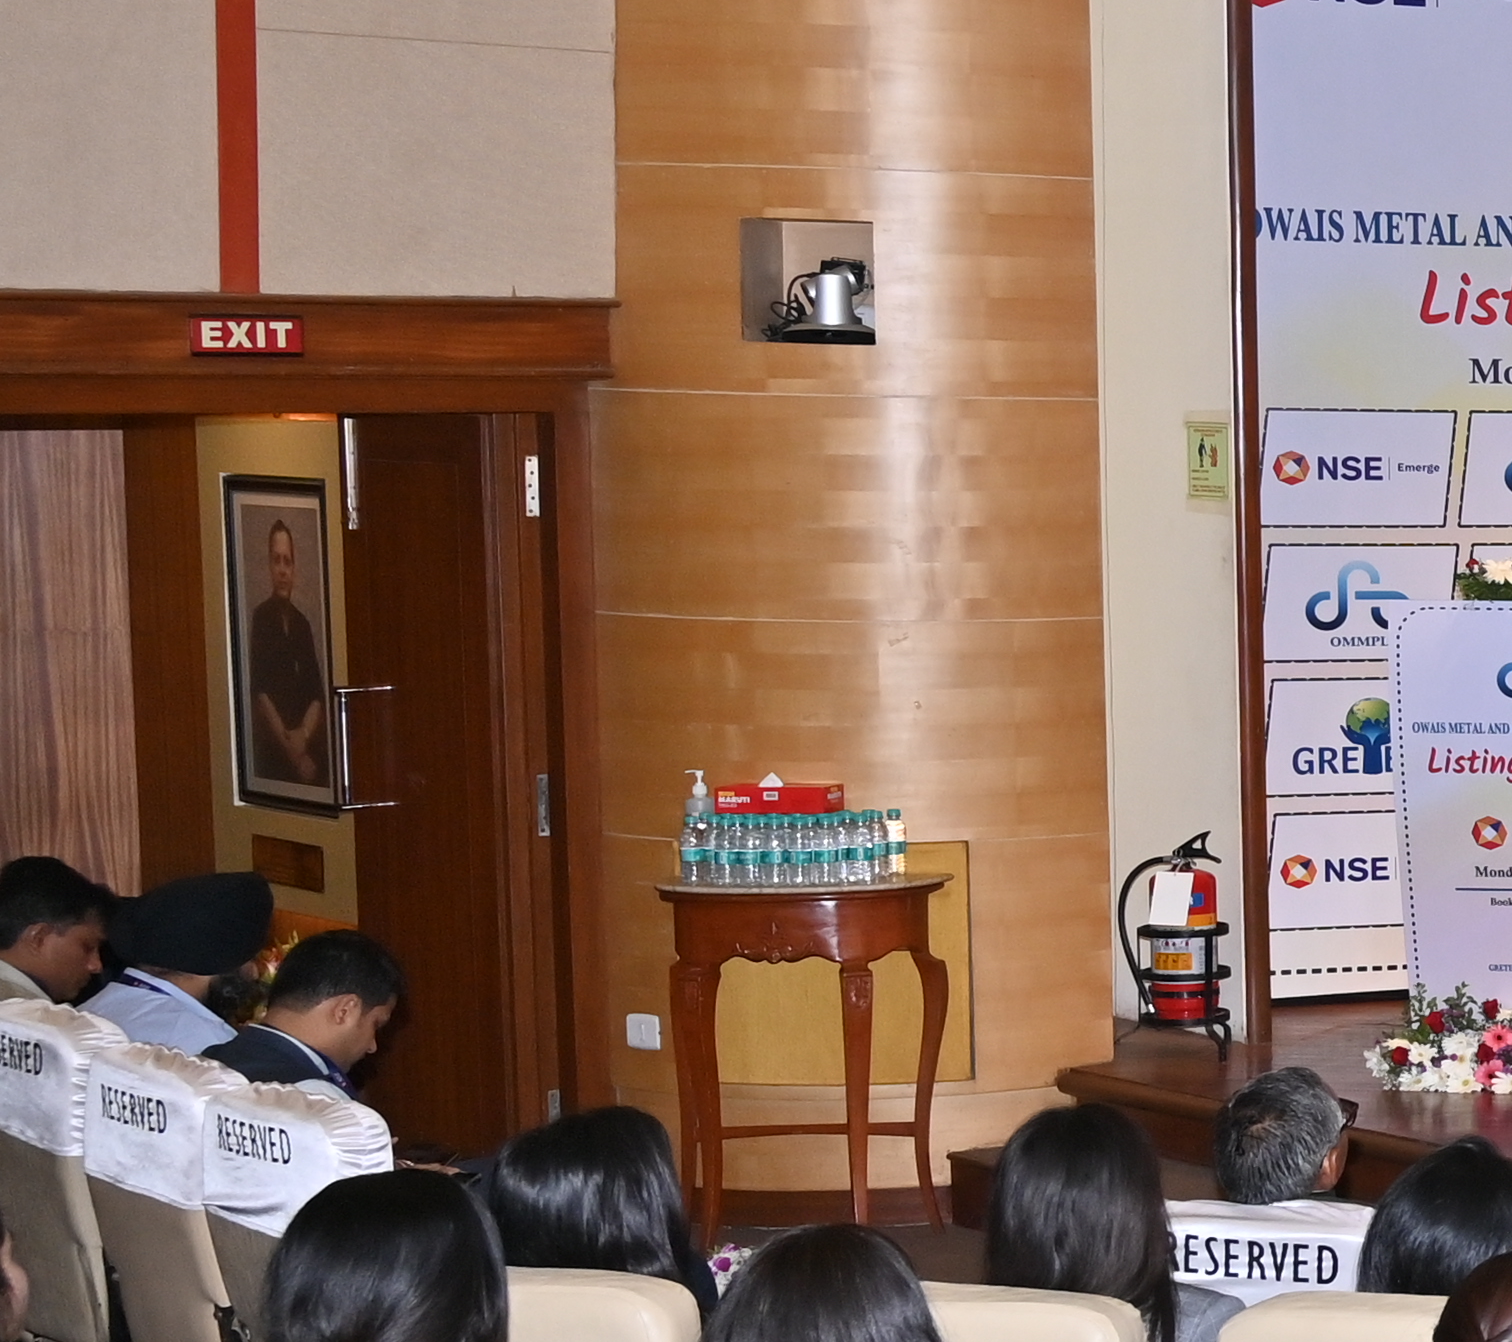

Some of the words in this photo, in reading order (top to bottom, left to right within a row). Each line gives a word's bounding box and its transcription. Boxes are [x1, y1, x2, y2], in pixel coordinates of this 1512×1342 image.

[1353, 210, 1466, 246] METAL
[200, 321, 293, 349] EXIT
[1316, 455, 1384, 481] NSE
[1397, 462, 1440, 475] Emerge
[1412, 721, 1446, 734] OWAIS
[1449, 723, 1486, 735] METAL
[1488, 723, 1510, 735] AND
[718, 796, 750, 804] MARUTI
[1324, 856, 1390, 884] NSE
[100, 1083, 167, 1134] RESERVED
[217, 1113, 292, 1165] RESERVED
